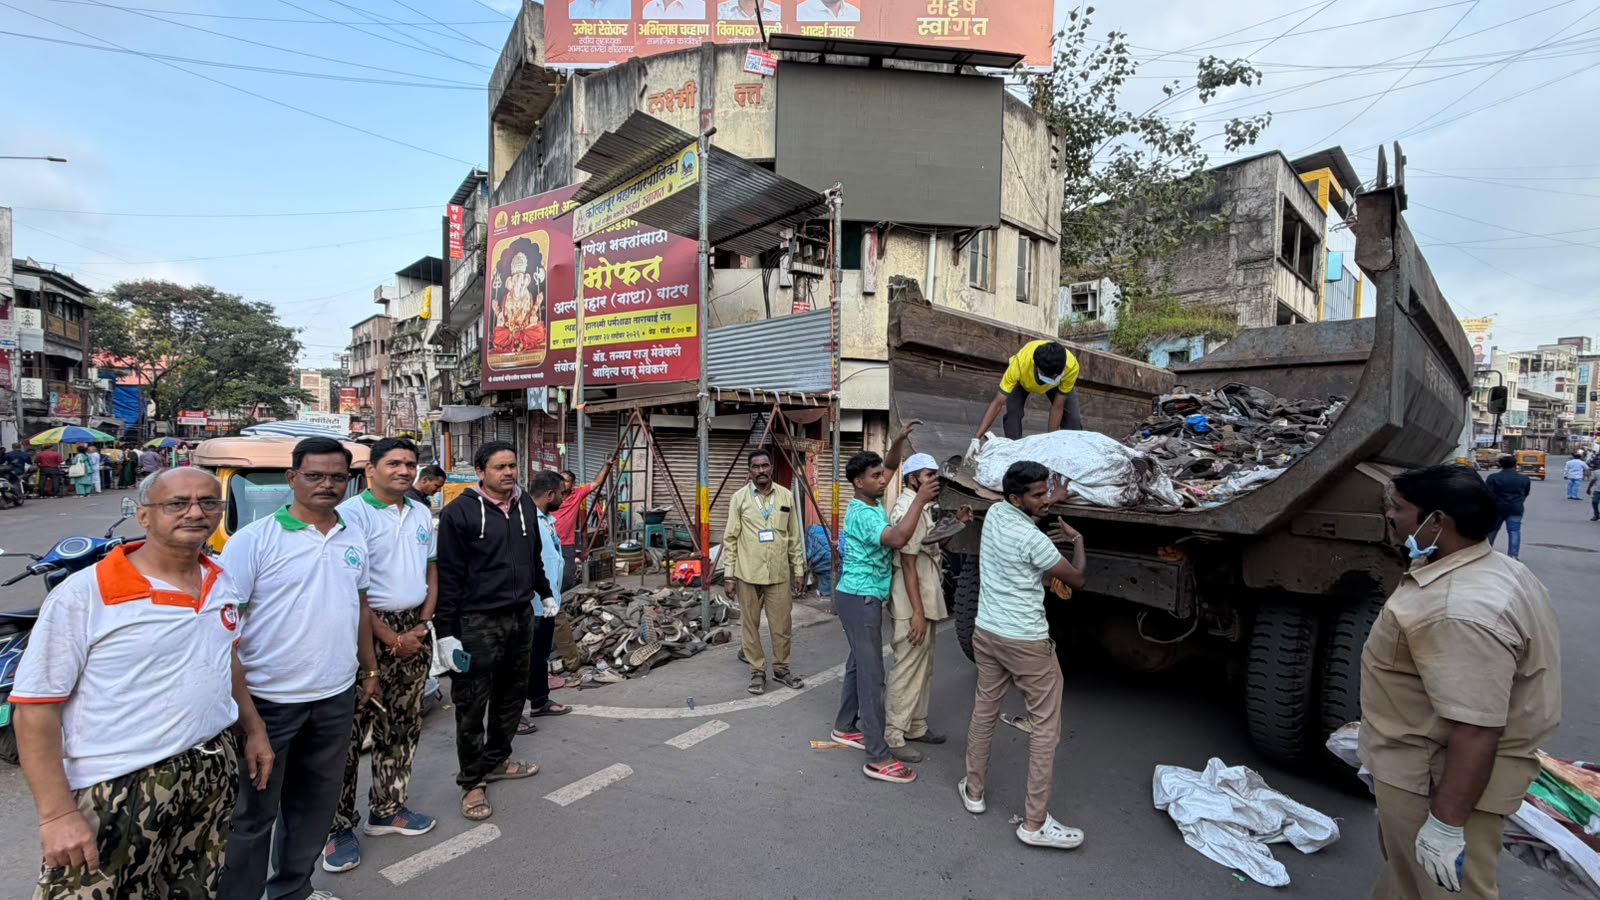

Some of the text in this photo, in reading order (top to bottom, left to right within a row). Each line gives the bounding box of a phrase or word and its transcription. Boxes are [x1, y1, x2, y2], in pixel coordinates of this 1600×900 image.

[572, 20, 629, 36] उमेश रेळेकर
[639, 20, 710, 36] अभिलाष चव्हाण
[716, 21, 755, 36] विनायक
[511, 211, 521, 226] श्री
[522, 200, 560, 224] महालक्ष्मी
[585, 193, 615, 218] कोल्हापूर
[584, 255, 663, 291] मोफत
[657, 283, 690, 299] वाटप
[593, 364, 619, 379] आदित्य
